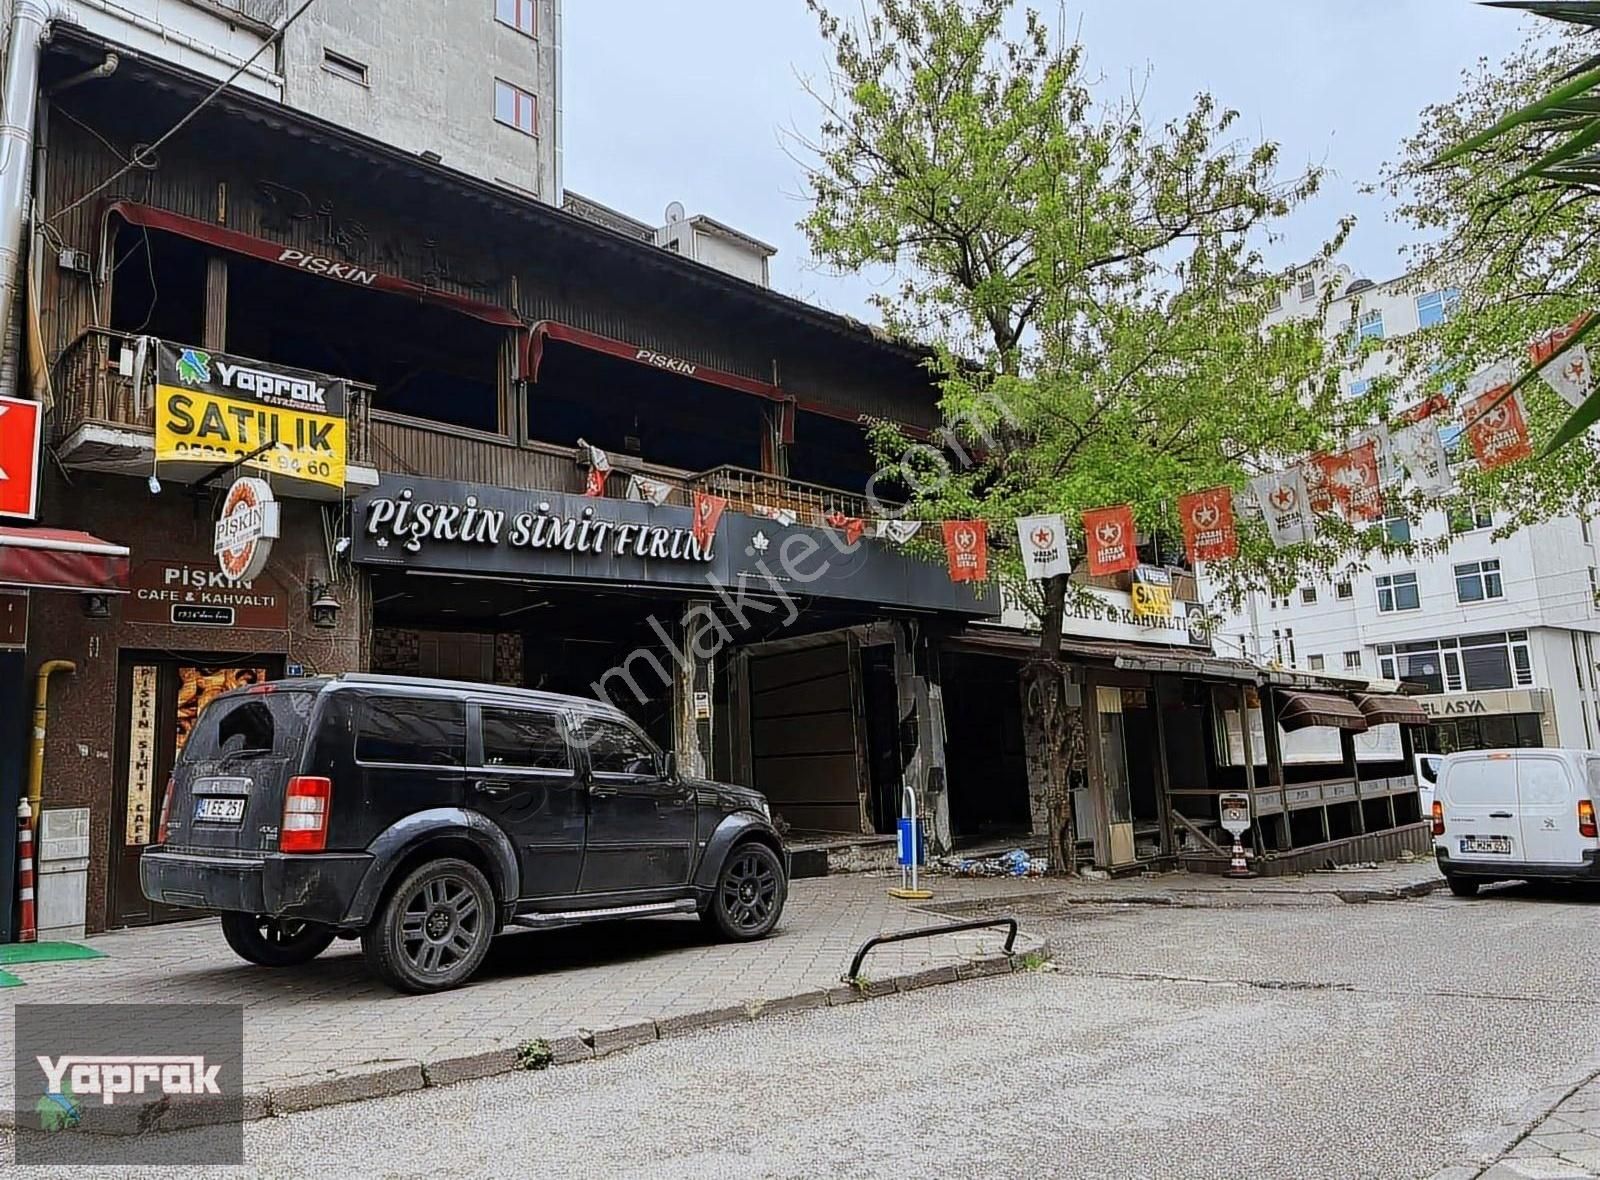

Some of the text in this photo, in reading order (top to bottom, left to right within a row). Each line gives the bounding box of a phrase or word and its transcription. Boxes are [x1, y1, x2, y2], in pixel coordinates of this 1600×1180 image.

[215, 361, 326, 404] Yaprak
[165, 394, 337, 452] SATILIK
[307, 460, 330, 477] 60
[366, 489, 504, 551] PİŞKİN
[509, 502, 614, 553] SİMİT
[137, 588, 275, 606] CAFE & KAHVALTI
[1445, 700, 1487, 714] ASYA
[211, 801, 225, 816] EE
